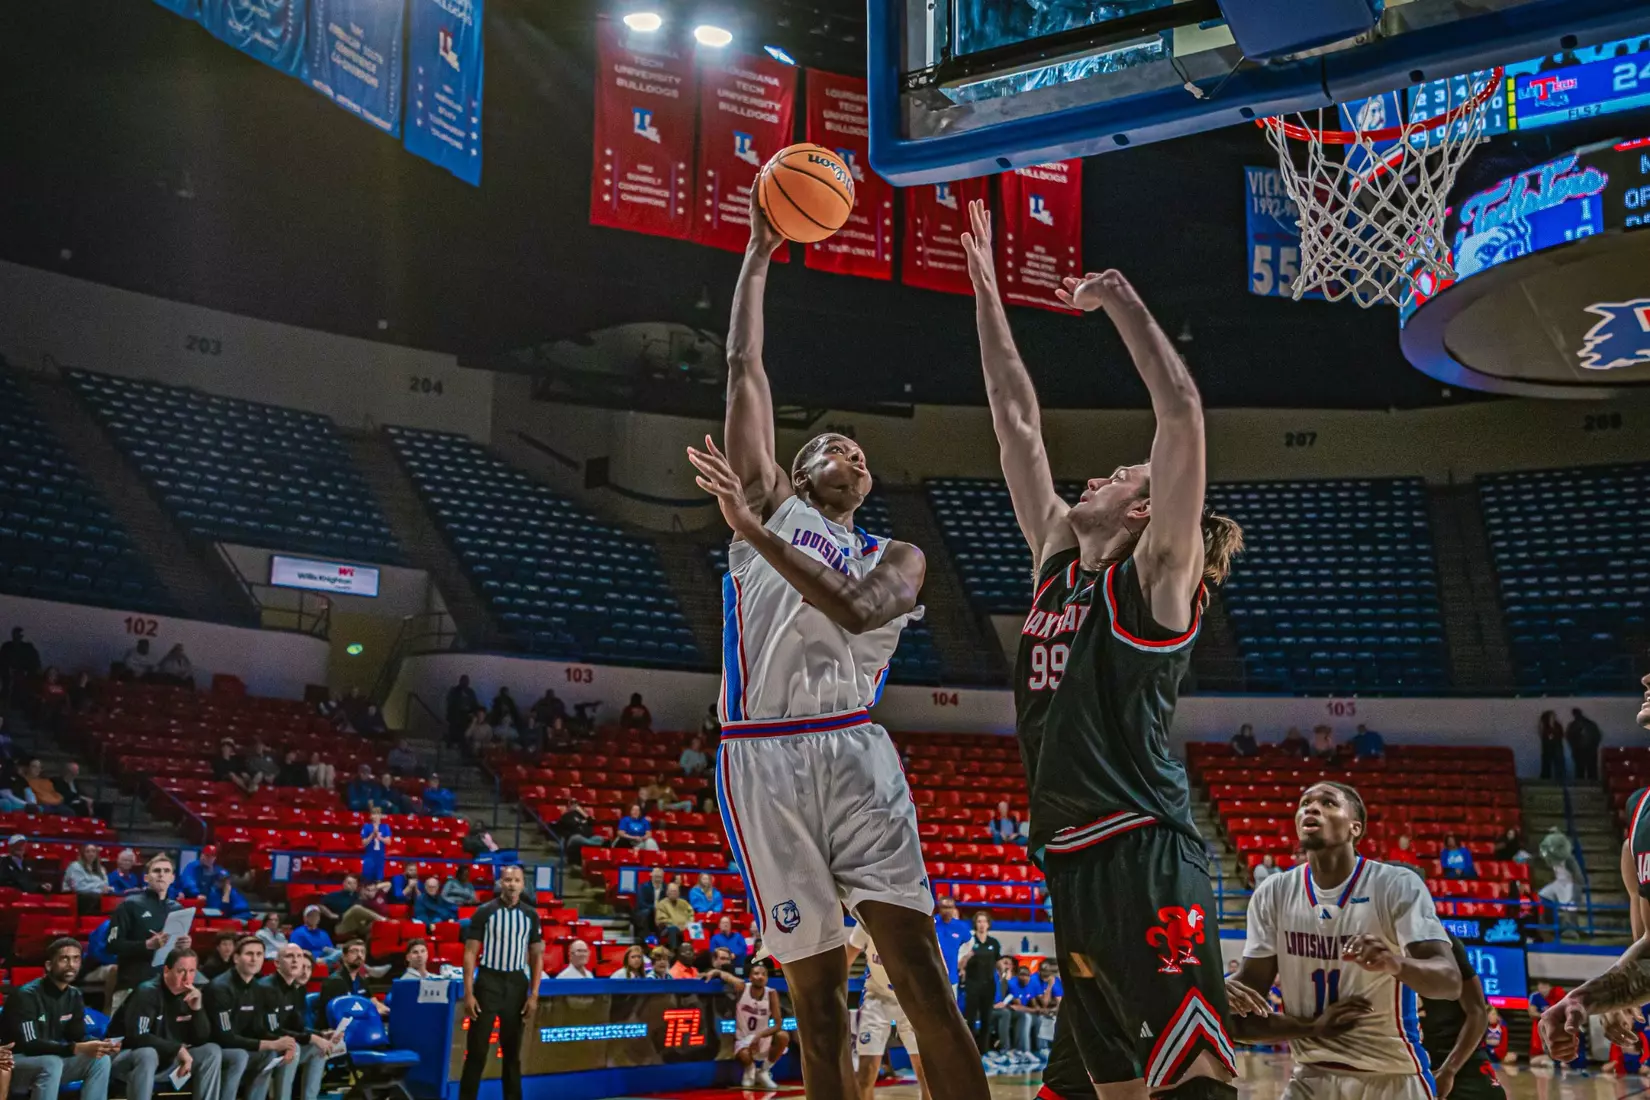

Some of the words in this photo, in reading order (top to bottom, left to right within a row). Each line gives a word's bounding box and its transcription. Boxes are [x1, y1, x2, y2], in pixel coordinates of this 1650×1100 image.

[613, 63, 682, 85] UNIVERSITY
[615, 77, 679, 98] BULLDOGS
[735, 80, 765, 96] TECH
[1434, 89, 1446, 102] 3
[1455, 85, 1467, 97] 4
[716, 87, 782, 111] UNIVERSITY
[838, 100, 865, 113] TECH
[1491, 96, 1503, 109] 0
[718, 101, 779, 125] BULLDOGS
[824, 121, 868, 137] BULLDOG
[1248, 171, 1286, 196] VICK
[1253, 244, 1298, 298] 55
[186, 334, 222, 356] 203
[409, 376, 443, 396] 204
[1285, 431, 1317, 448] 207
[791, 528, 850, 576] LOUISIA
[124, 616, 158, 638] 102
[565, 667, 593, 684] 103
[1029, 644, 1069, 690] 99
[932, 692, 959, 707] 104
[1326, 701, 1356, 717] 105
[1312, 968, 1341, 1016] 11
[540, 1023, 647, 1043] TICKETSFORLESS.COM
[664, 1008, 705, 1047] TFL
[748, 1016, 758, 1032] 0
